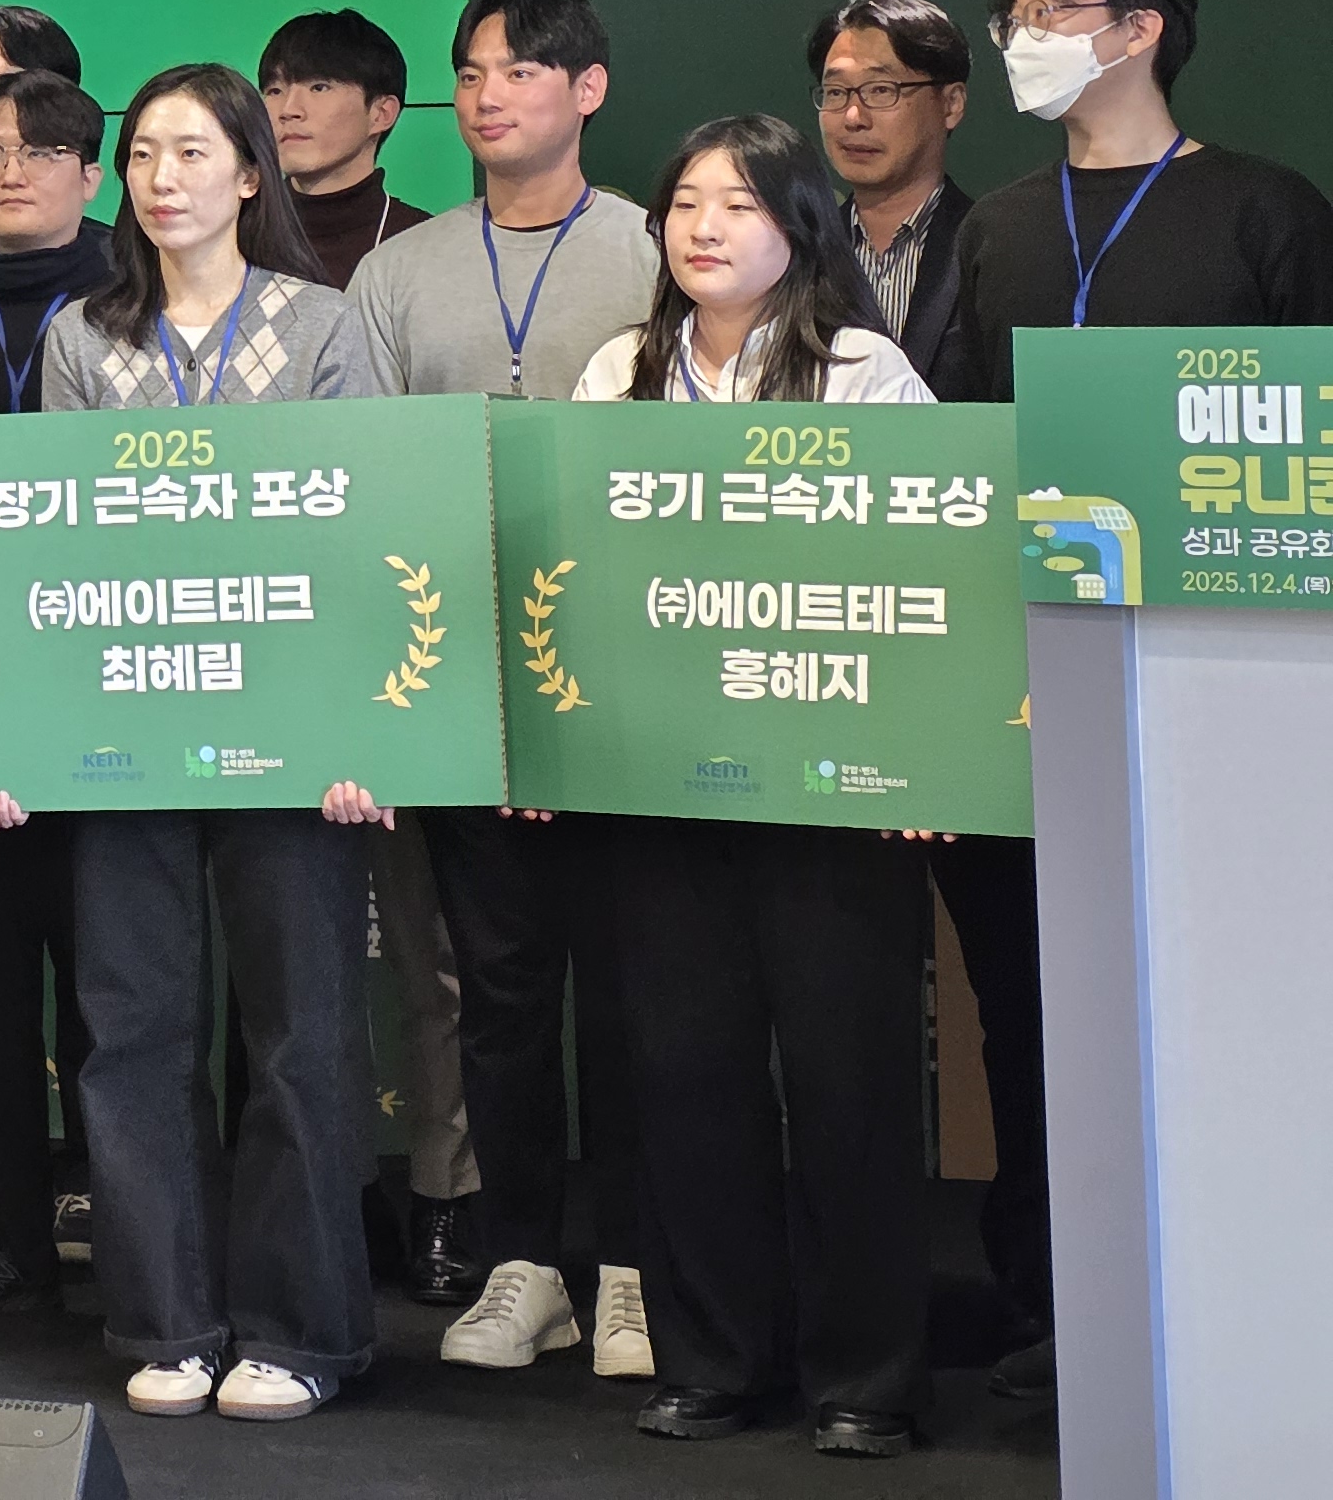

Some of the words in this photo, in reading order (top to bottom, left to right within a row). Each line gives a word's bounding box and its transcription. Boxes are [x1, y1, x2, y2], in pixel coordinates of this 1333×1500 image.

[1176, 348, 1261, 380] 2025
[1177, 384, 1304, 444] 예비
[113, 429, 215, 470] 2025
[744, 426, 851, 467] 2025
[93, 472, 238, 525] 근속자
[251, 467, 350, 517] 포상
[608, 471, 704, 521] 장기
[720, 472, 874, 525] 근속자
[886, 476, 994, 527] 포상
[1181, 527, 1243, 557] 성과
[102, 642, 243, 693] 최혜림
[720, 648, 869, 704] 홍혜지
[83, 753, 132, 768] KEITI
[696, 762, 748, 779] KEITI
